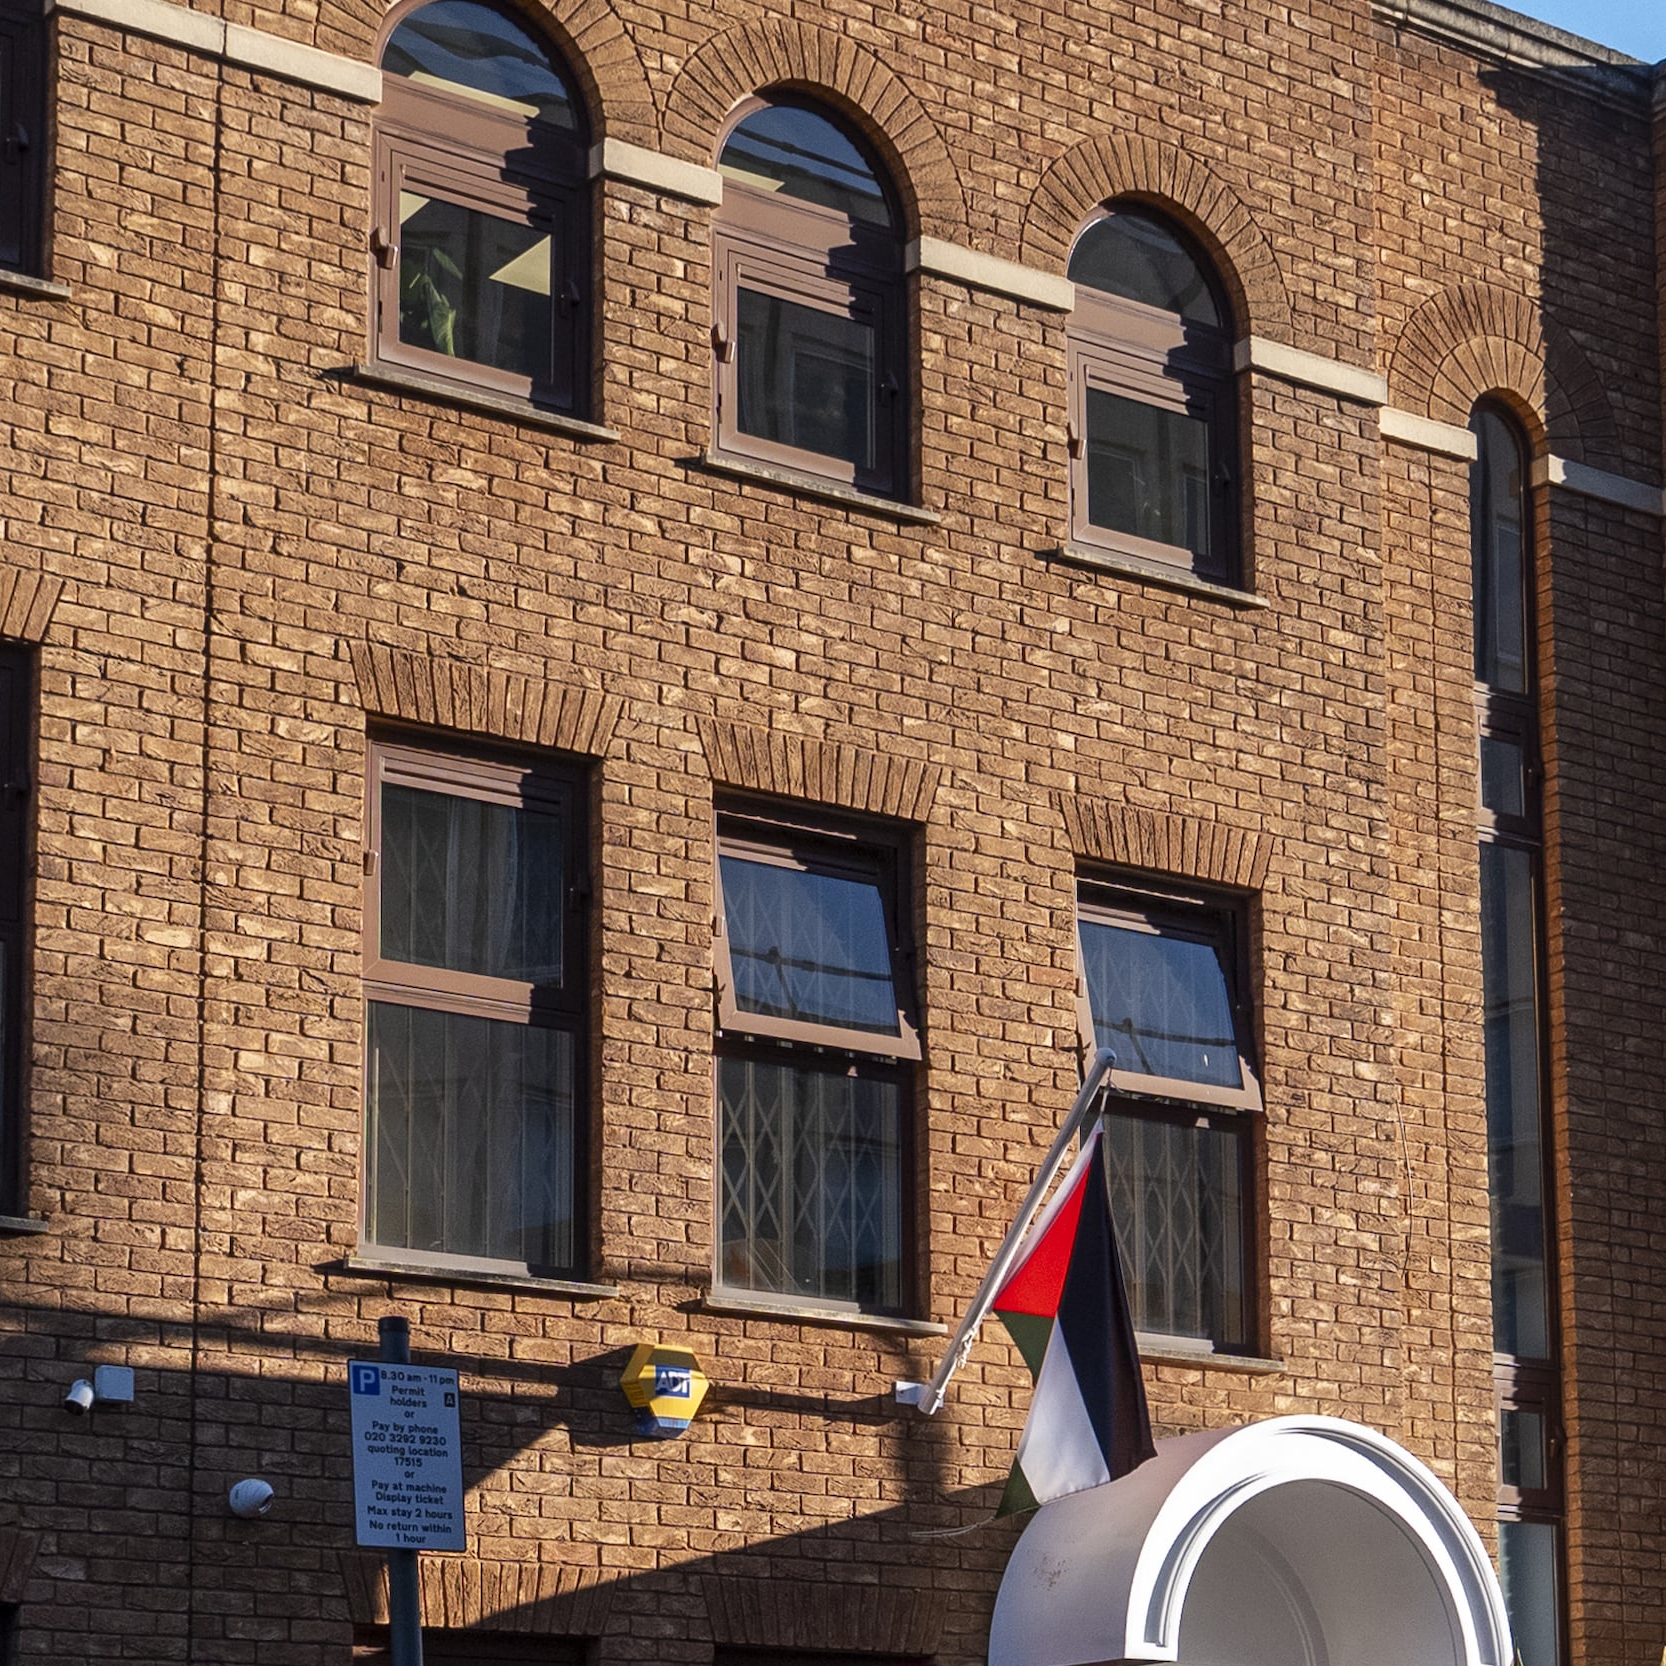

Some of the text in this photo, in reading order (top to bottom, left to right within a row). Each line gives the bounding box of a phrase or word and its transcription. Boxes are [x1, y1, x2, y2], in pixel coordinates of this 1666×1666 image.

[359, 1369, 376, 1392] P
[380, 1370, 405, 1381] 8.30
[407, 1374, 421, 1382] am
[429, 1375, 437, 1383] 11
[439, 1377, 455, 1385] pm
[656, 1371, 691, 1393] ADT
[391, 1385, 425, 1396] Permit
[390, 1396, 427, 1408] holders
[404, 1410, 414, 1418] or
[372, 1420, 438, 1434] Pay by phone
[365, 1431, 386, 1442] 020
[419, 1435, 446, 1446] 9230
[367, 1444, 448, 1457] quoting location
[395, 1457, 422, 1467] 17515
[372, 1480, 447, 1493] Pay at machine
[376, 1492, 444, 1504] Display ticket
[367, 1505, 453, 1519] Max stay 2 hours
[369, 1520, 452, 1533] No return within
[403, 1533, 426, 1543] hour
